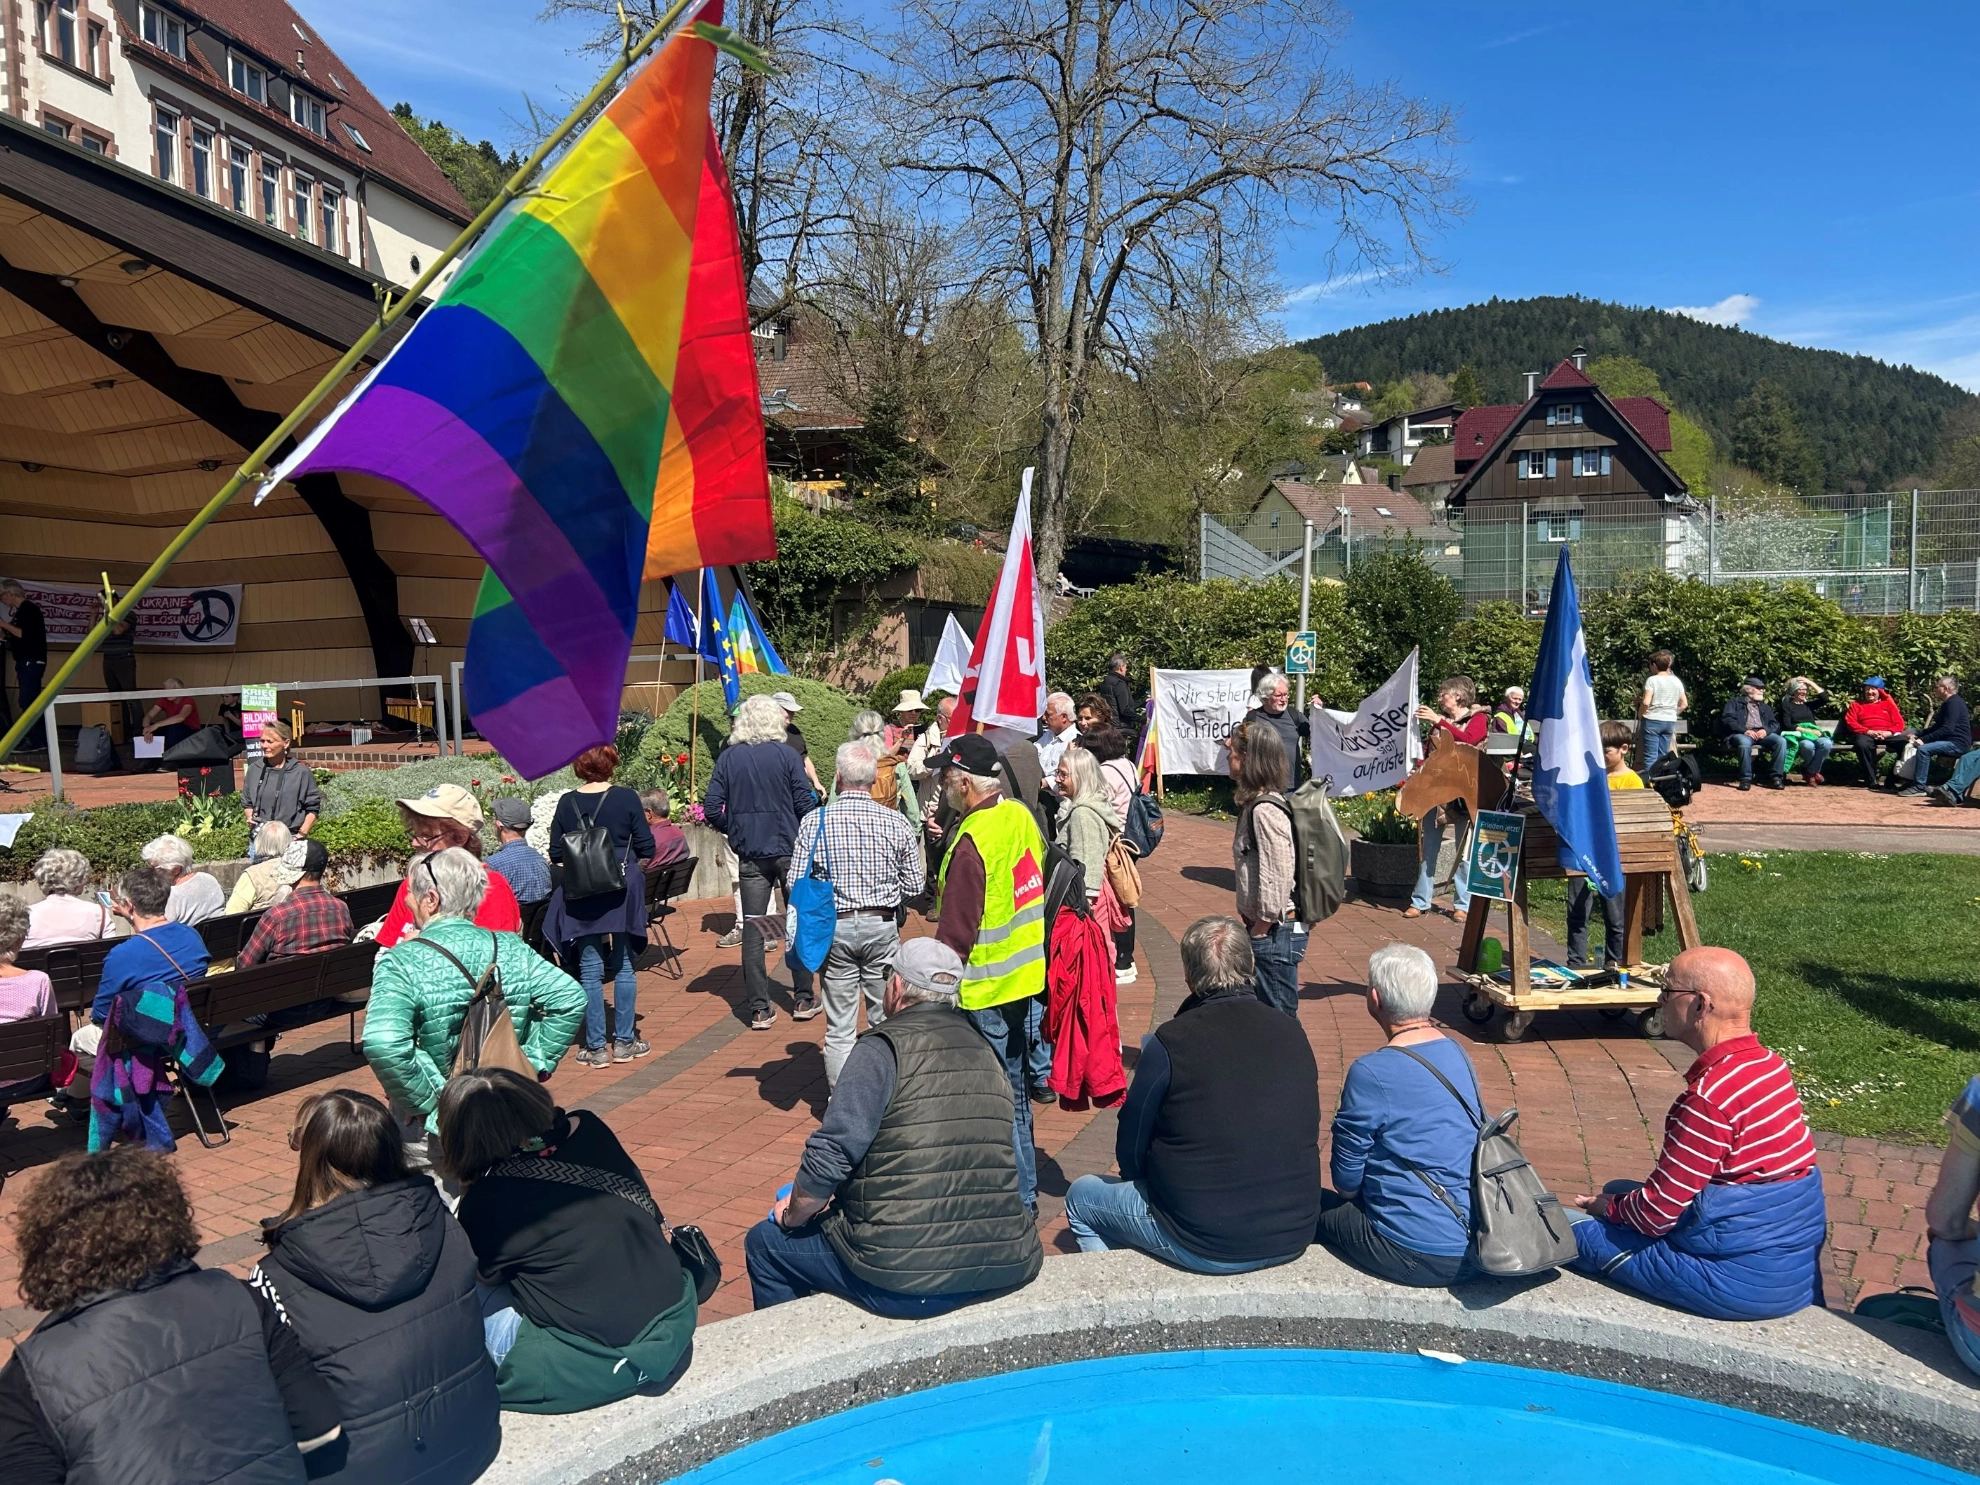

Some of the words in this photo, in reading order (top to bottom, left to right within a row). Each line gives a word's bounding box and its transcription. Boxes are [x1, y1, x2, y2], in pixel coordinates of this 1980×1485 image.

[41, 593, 62, 603] DAS
[152, 612, 200, 625] LÖSUNG!
[243, 688, 276, 697] KRIEG
[1172, 683, 1201, 705] Wir
[1207, 683, 1252, 703] stehen
[243, 712, 276, 723] BILDUNG
[1175, 718, 1191, 739] für
[1376, 738, 1397, 755] statt
[1480, 821, 1504, 830] Frieden
[1504, 825, 1521, 833] jetzt!
